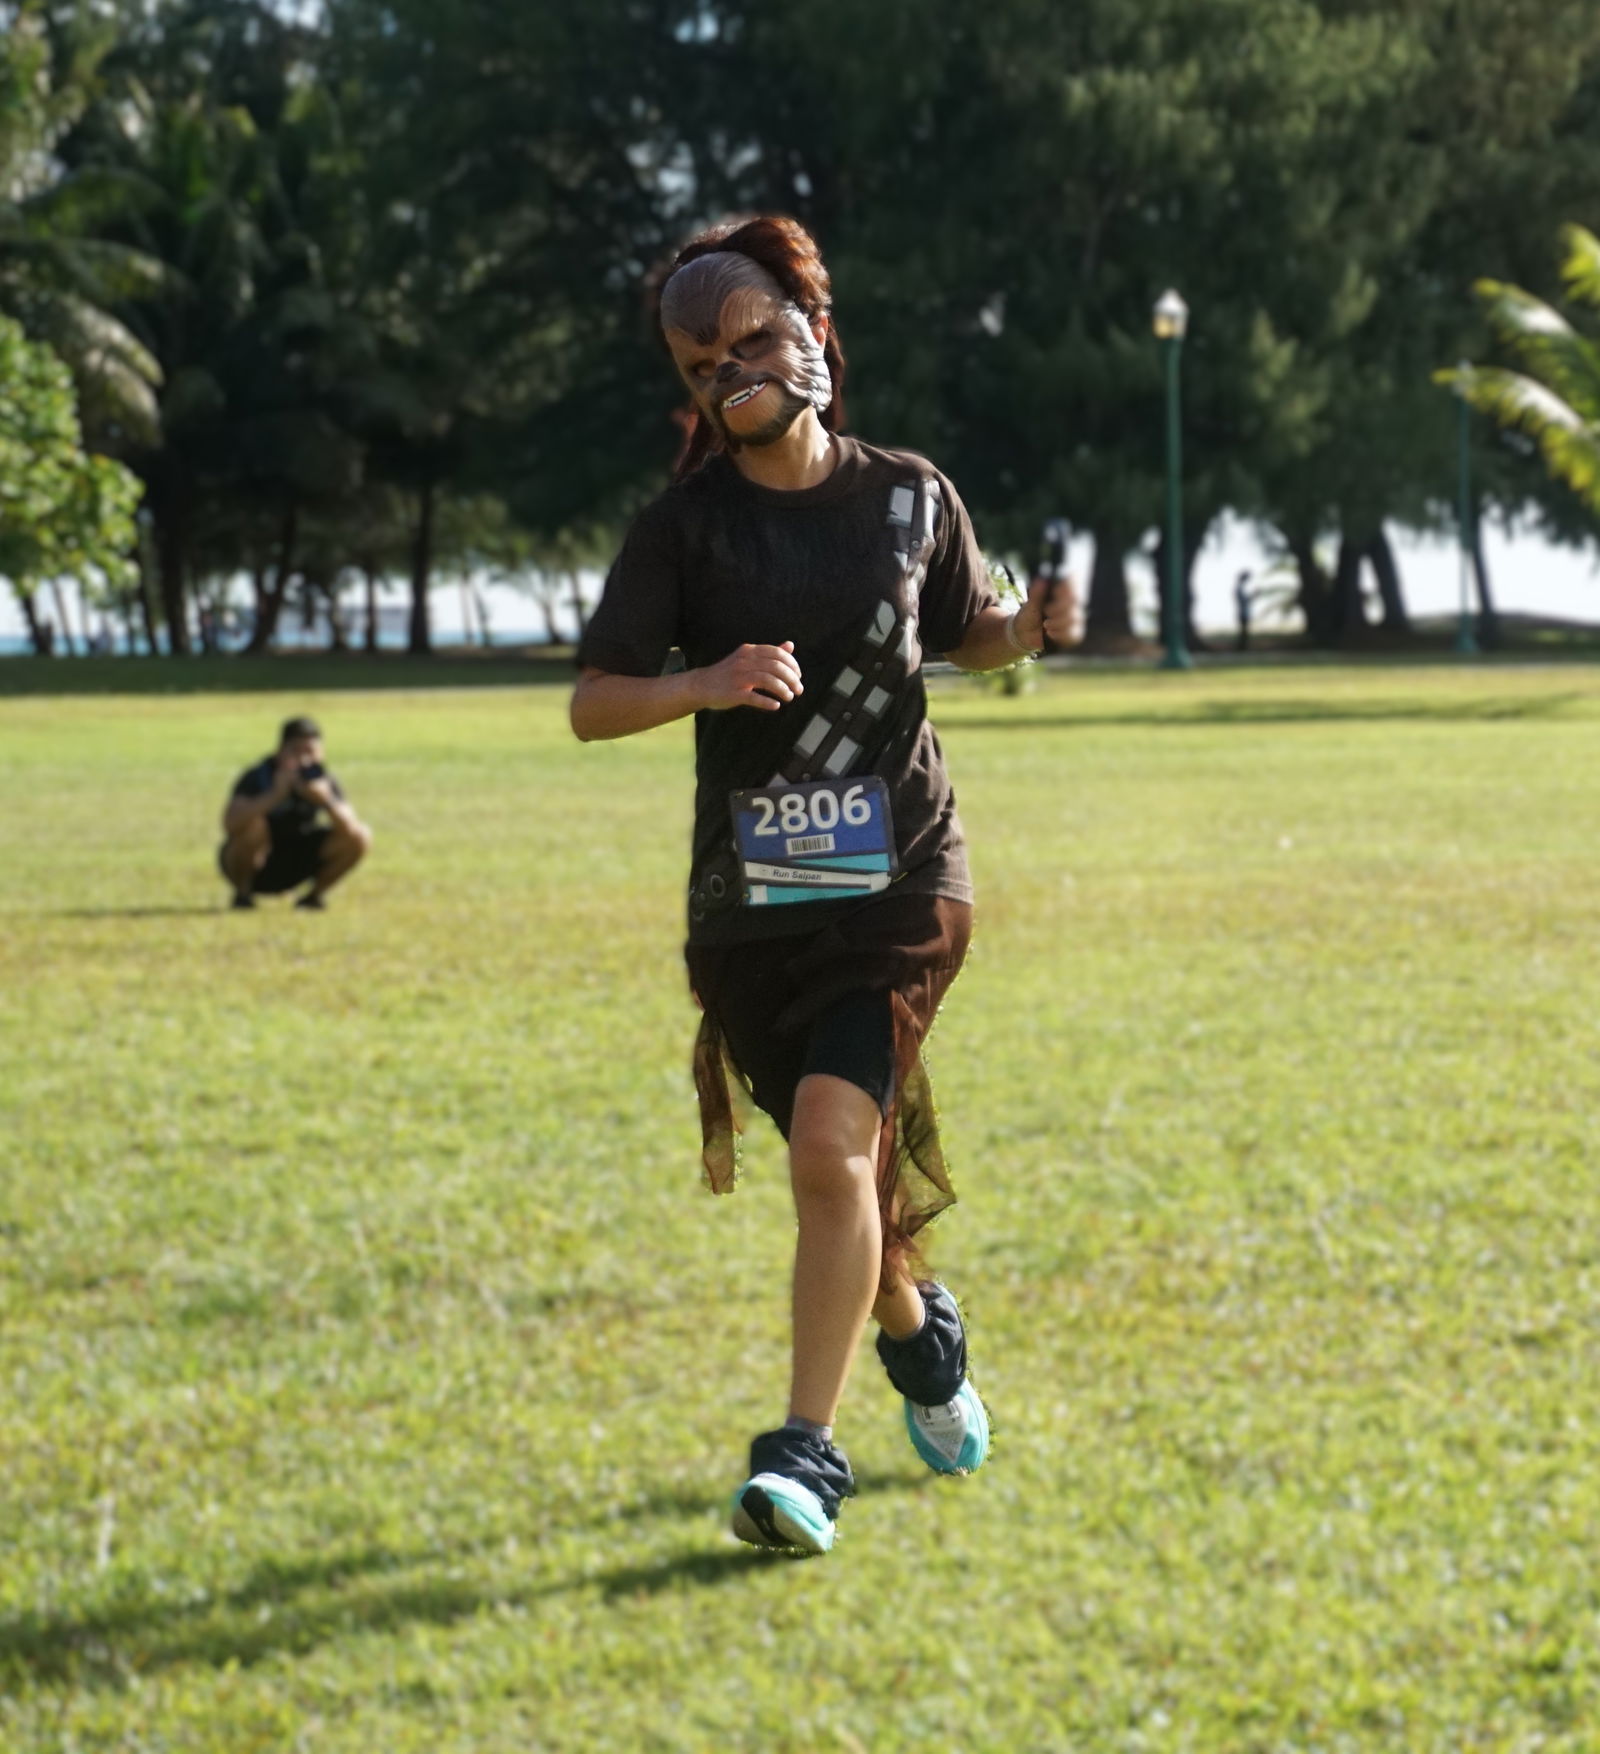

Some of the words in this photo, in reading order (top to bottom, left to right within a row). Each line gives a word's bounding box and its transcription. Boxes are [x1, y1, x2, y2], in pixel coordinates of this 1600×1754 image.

[751, 784, 872, 836] 2806
[773, 869, 789, 879] Run
[792, 870, 822, 881] Saipan
